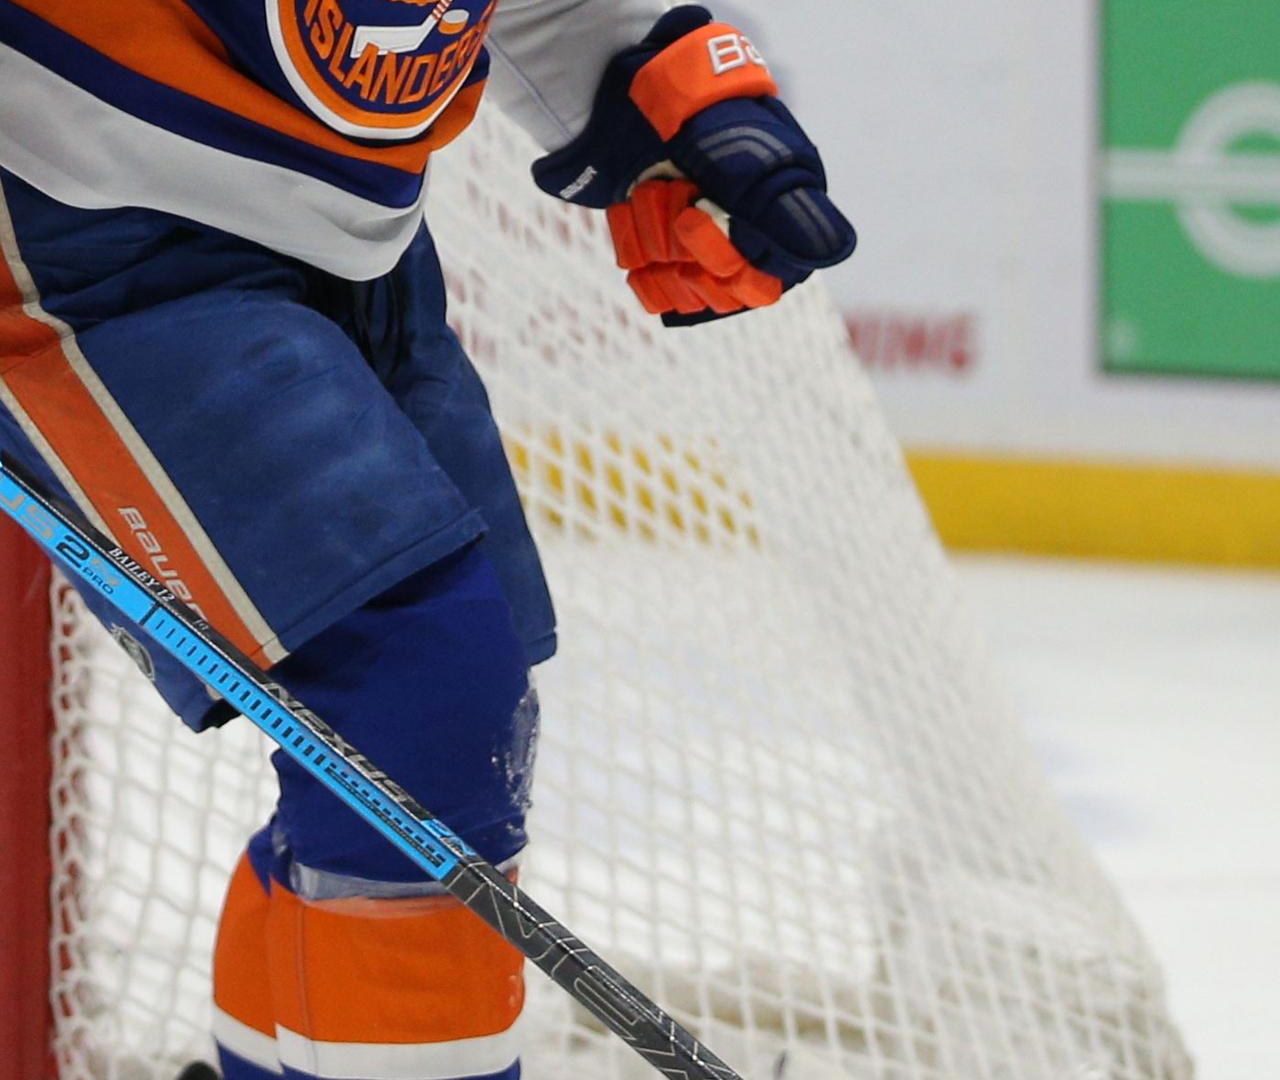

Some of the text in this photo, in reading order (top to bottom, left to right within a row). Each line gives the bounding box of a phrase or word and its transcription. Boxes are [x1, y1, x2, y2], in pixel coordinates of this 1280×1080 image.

[82, 565, 115, 596] PRO
[108, 546, 176, 604] BAILEY 12
